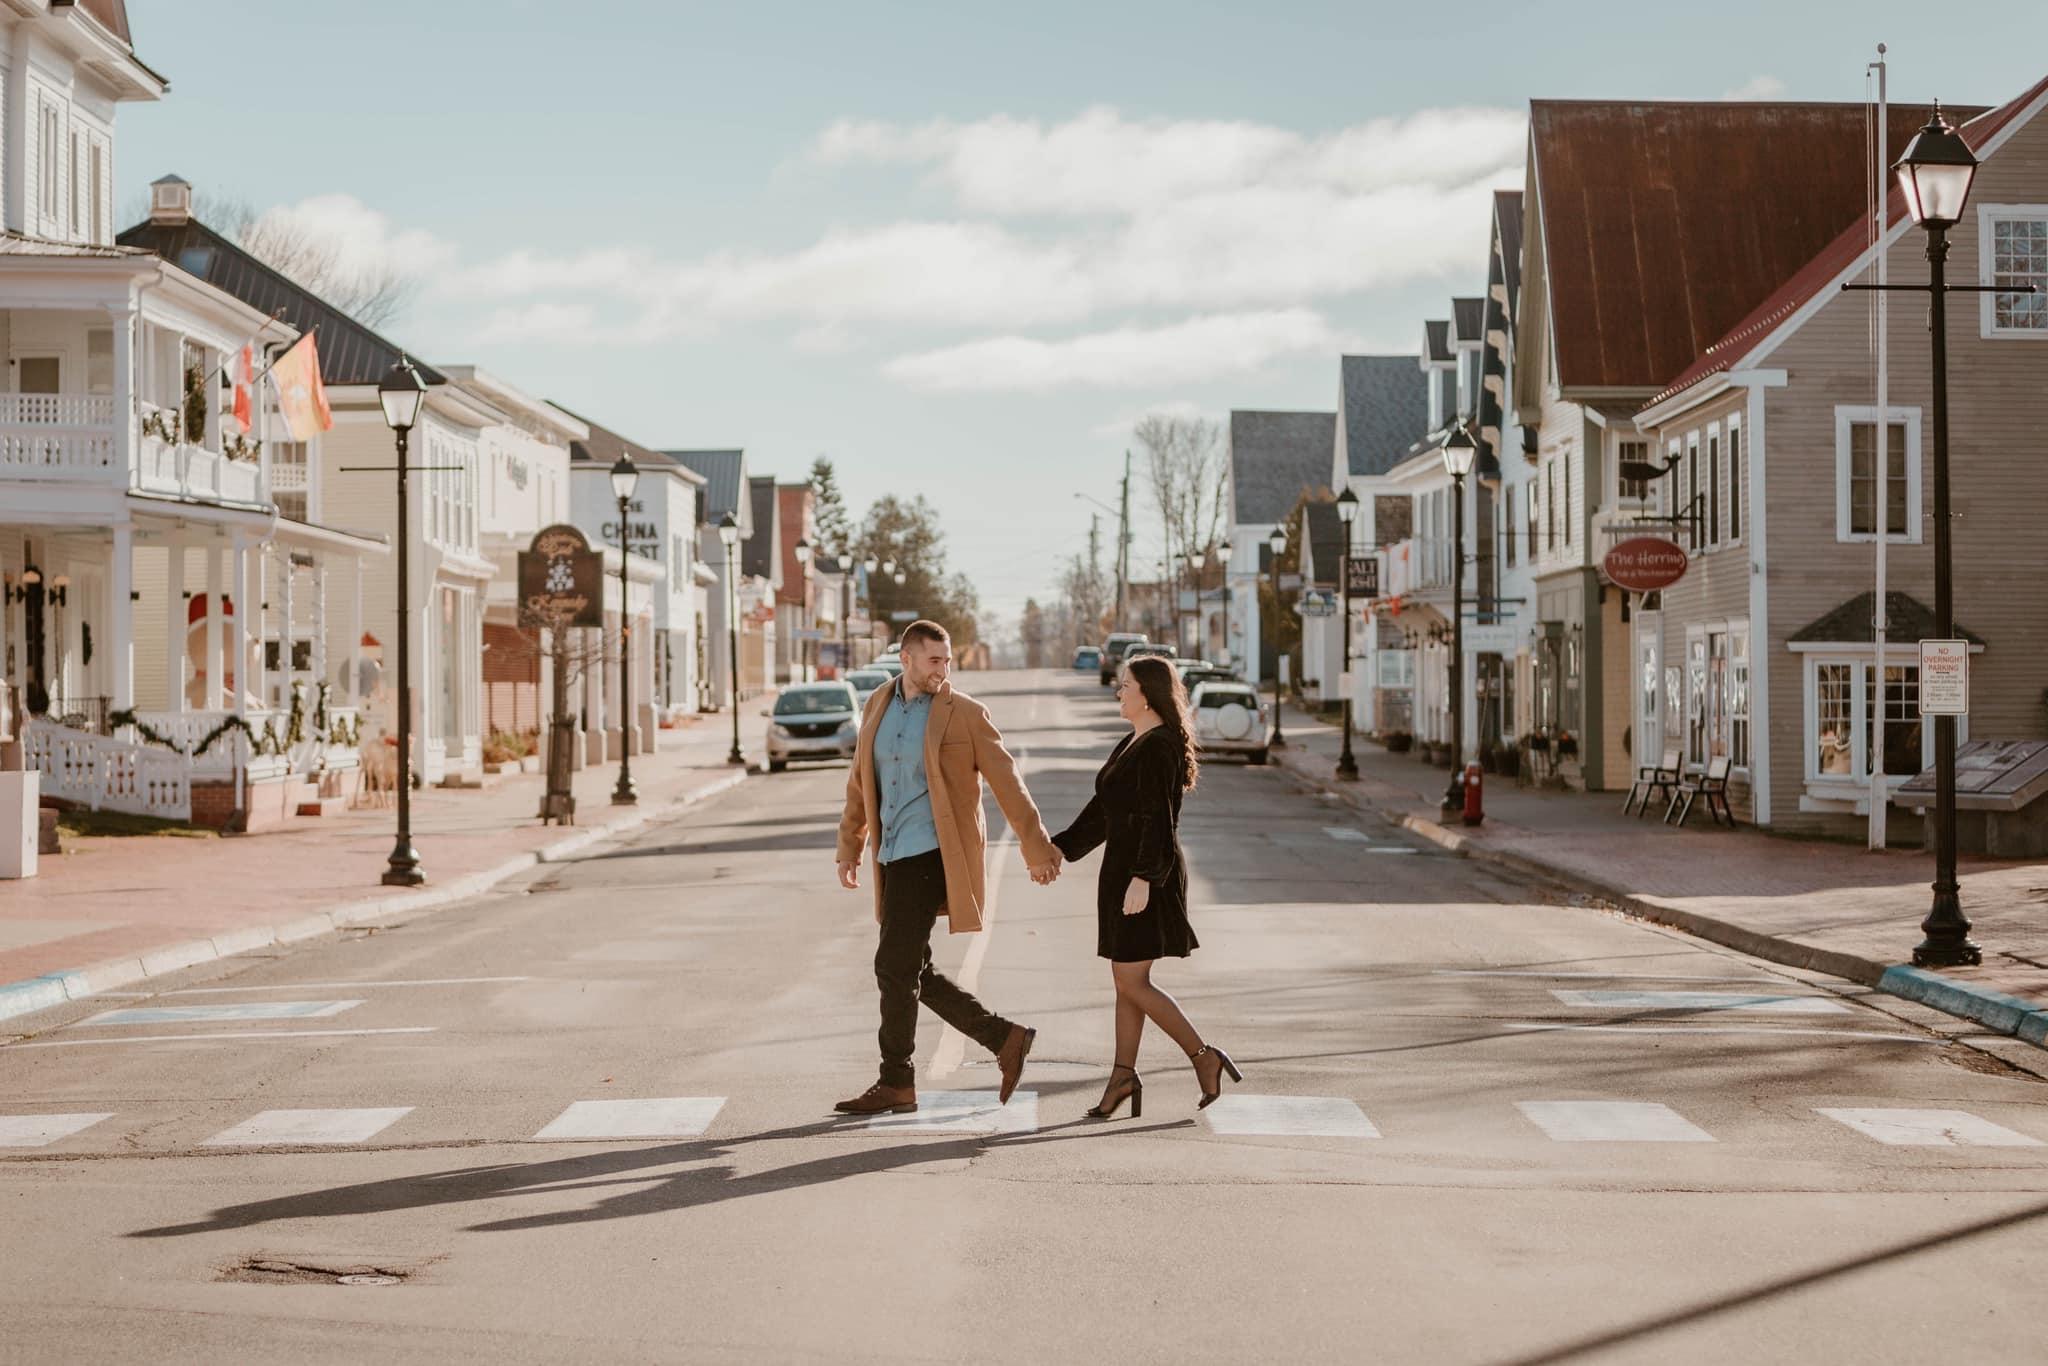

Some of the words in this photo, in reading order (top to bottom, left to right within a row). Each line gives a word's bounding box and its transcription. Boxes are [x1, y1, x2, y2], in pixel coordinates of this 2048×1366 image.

[601, 522, 658, 539] CHINA
[1607, 552, 1633, 567] The
[1638, 549, 1685, 568] Herring
[1928, 664, 1959, 672] PARKING
